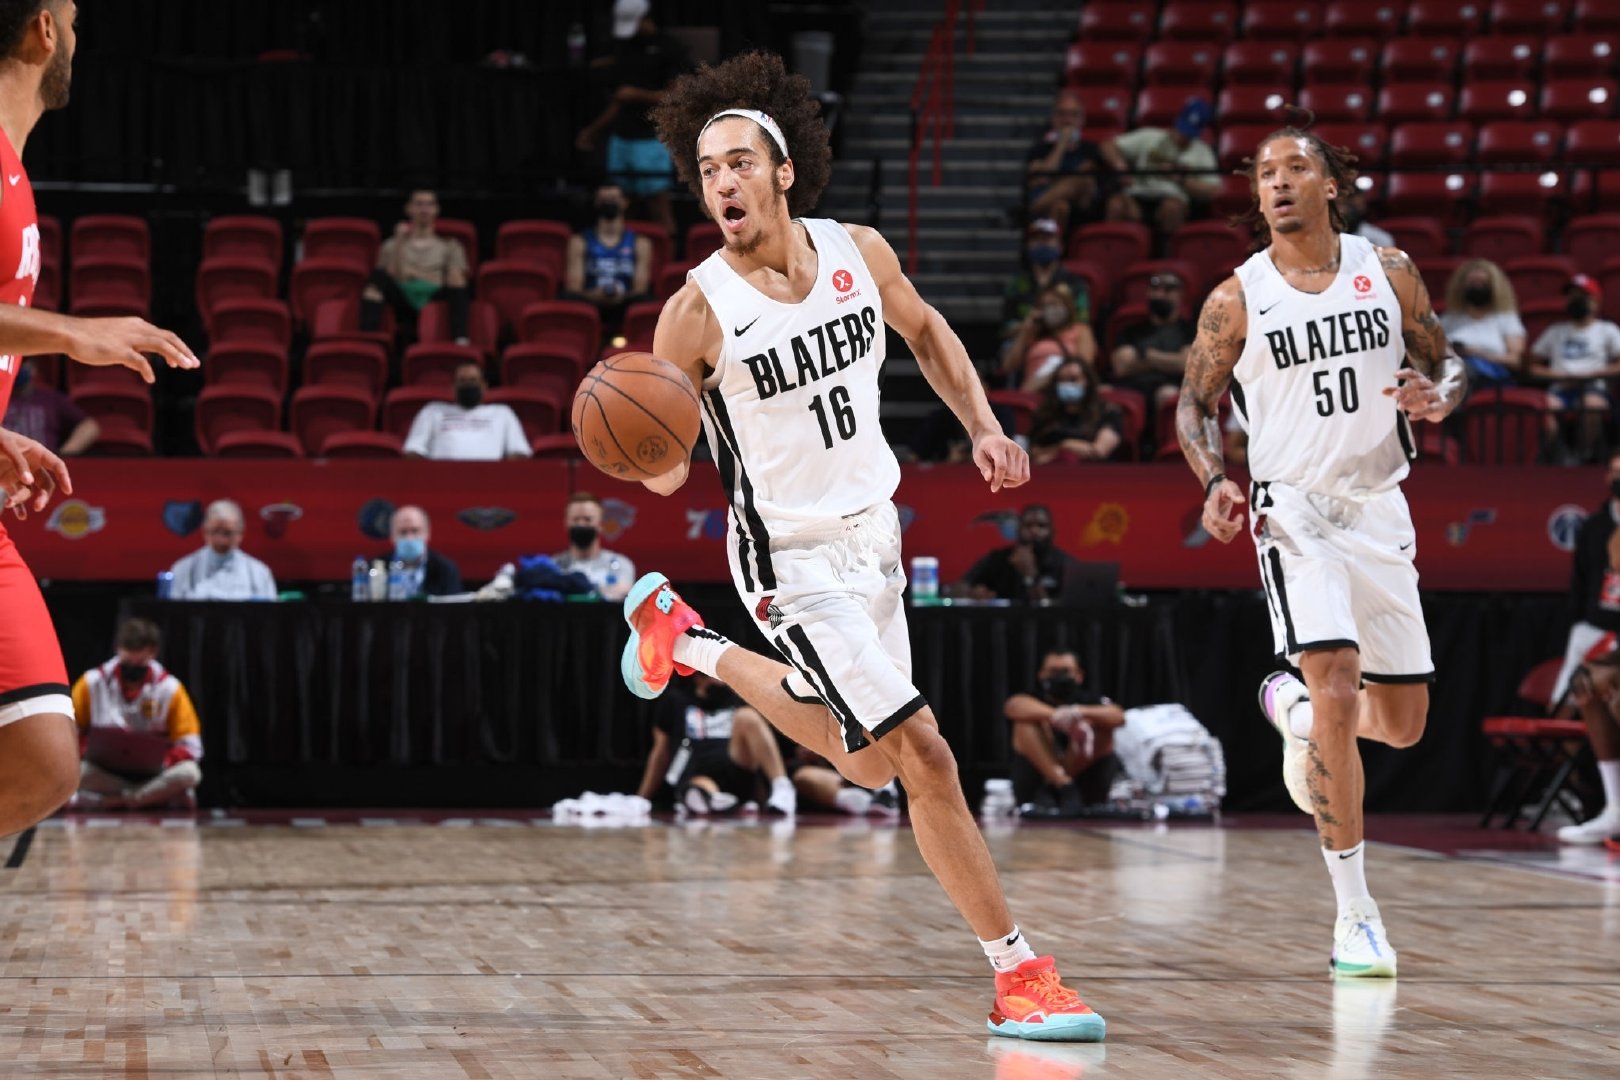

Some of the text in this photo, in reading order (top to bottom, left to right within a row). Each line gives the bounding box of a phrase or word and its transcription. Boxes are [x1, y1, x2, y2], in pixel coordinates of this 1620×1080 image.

[741, 306, 876, 400] BLAZERS
[1264, 307, 1390, 370] BLAZERS
[808, 385, 857, 450] 16
[1312, 366, 1359, 417] 50
